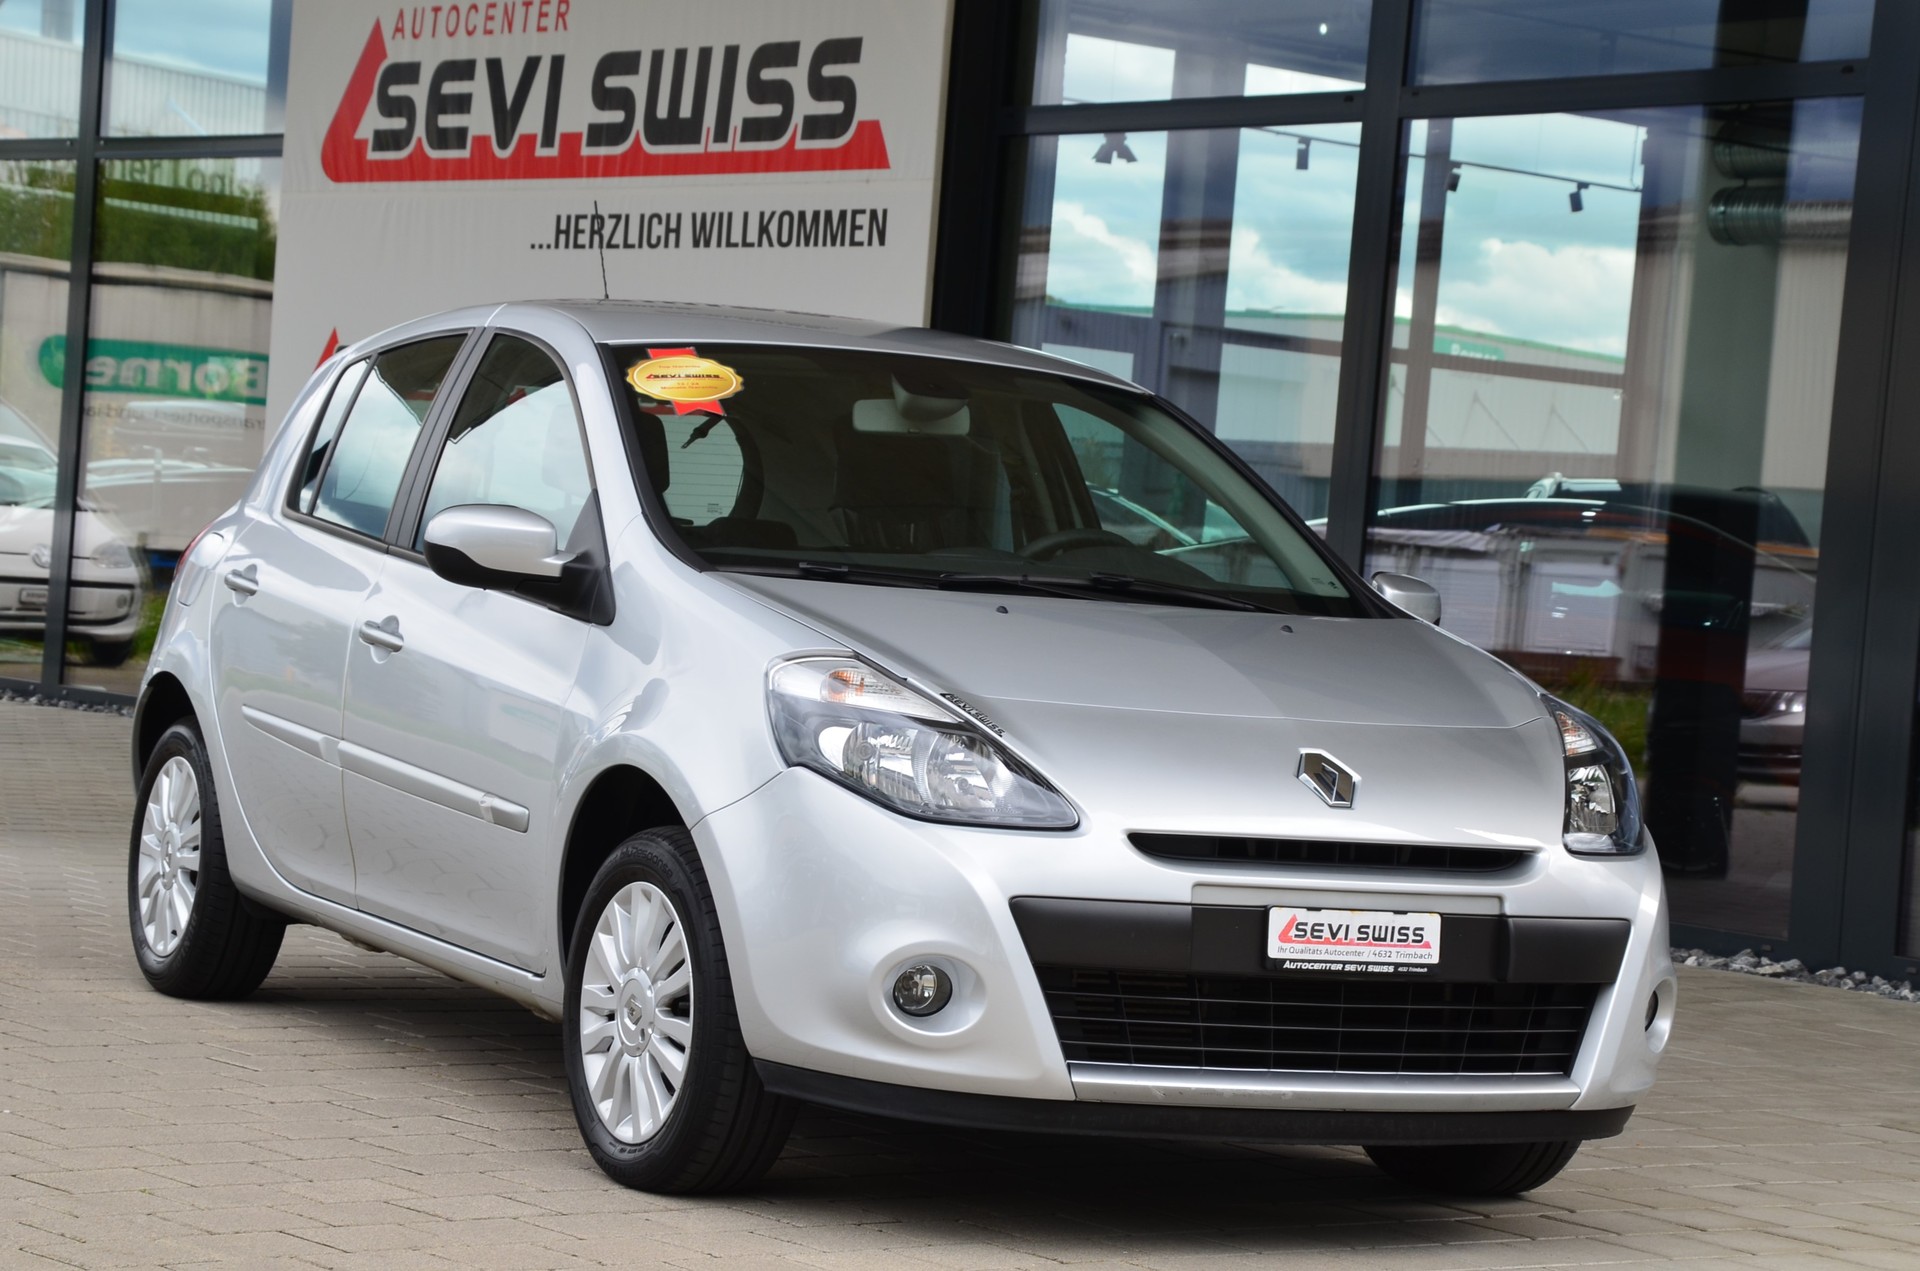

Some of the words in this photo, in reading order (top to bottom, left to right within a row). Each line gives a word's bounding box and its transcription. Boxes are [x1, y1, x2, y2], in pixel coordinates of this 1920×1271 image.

[391, 0, 571, 40] AUTOCENTER
[371, 54, 566, 152] SEVI
[585, 36, 864, 148] SWISS
[691, 208, 888, 248] WILLKOMMEN
[1293, 921, 1350, 941] SEVI
[1356, 924, 1425, 944] SWISS
[1277, 945, 1289, 954] Ihr
[1324, 948, 1366, 957] Autocenter
[1372, 950, 1393, 959] 4632
[1395, 951, 1433, 960] Trimbach
[1344, 963, 1367, 972] SEVI
[1367, 964, 1395, 973] SWISS
